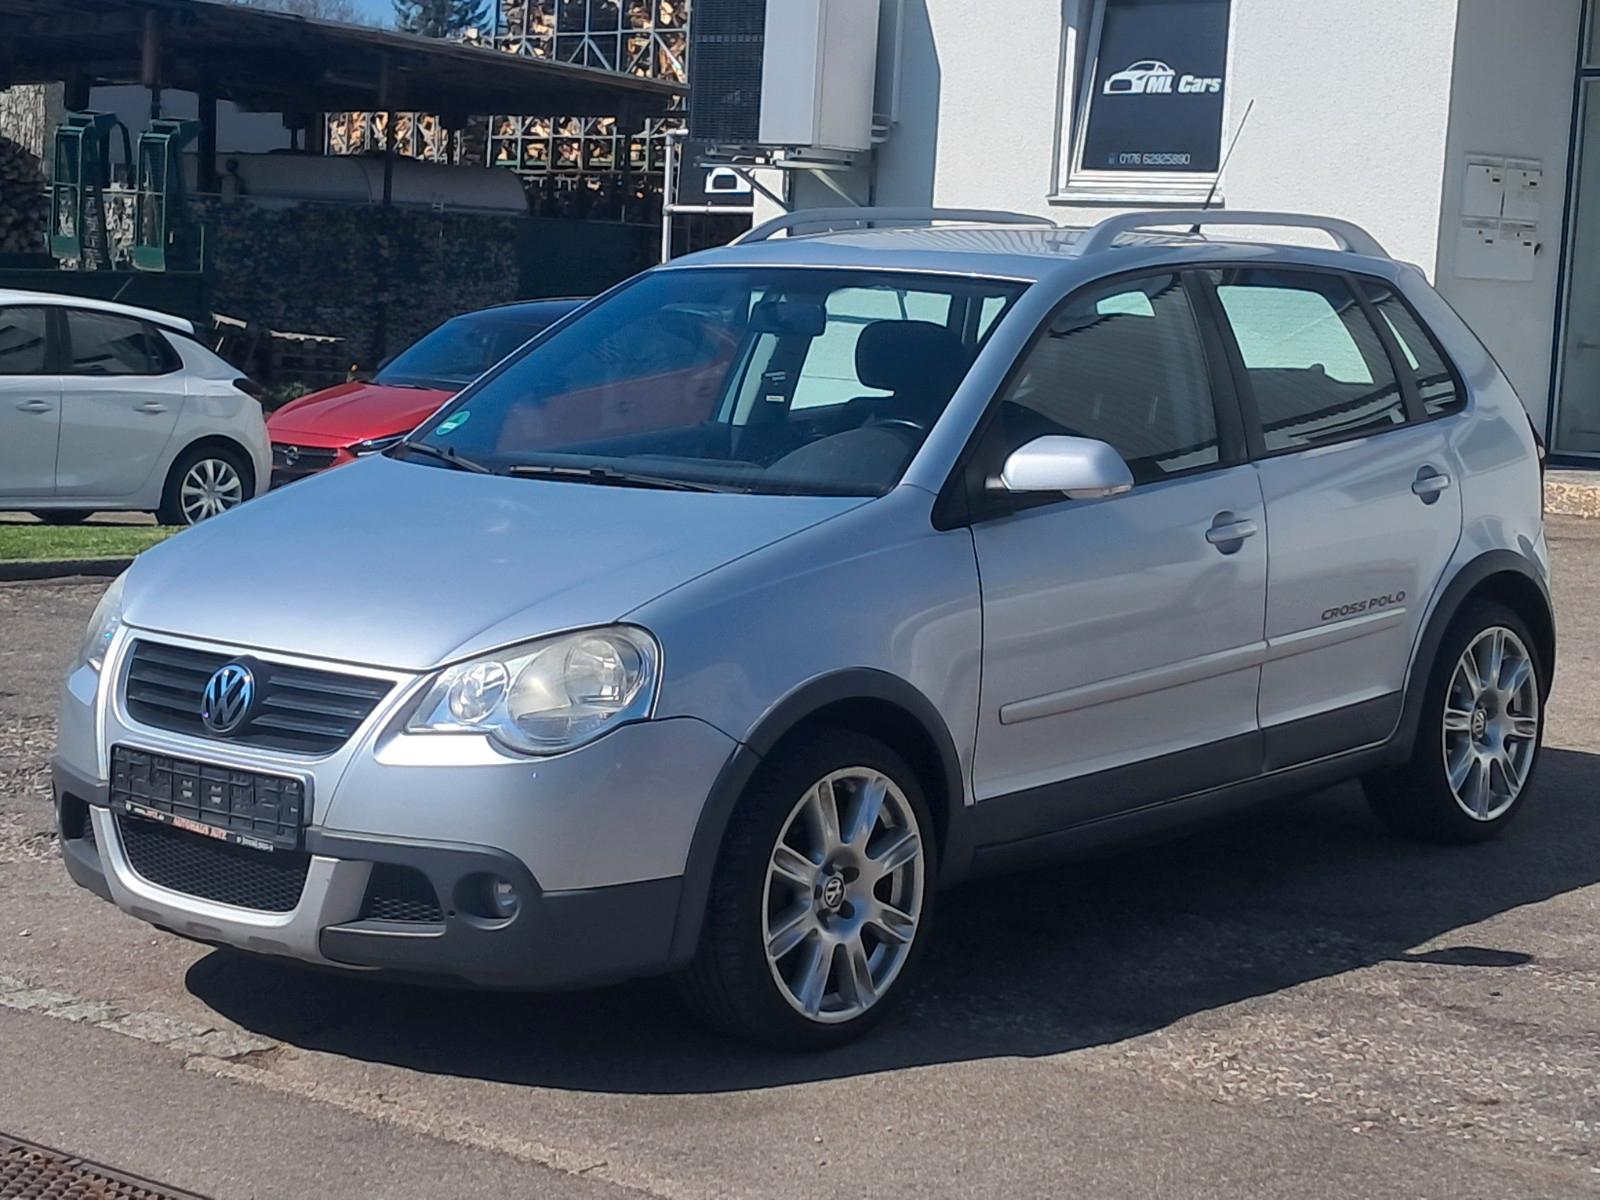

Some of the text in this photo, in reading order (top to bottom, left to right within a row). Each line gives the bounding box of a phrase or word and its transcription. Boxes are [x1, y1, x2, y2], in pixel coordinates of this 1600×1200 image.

[1145, 74, 1221, 93] ML Cars
[1120, 153, 1141, 165] 0176
[1321, 590, 1406, 620] CROSS POLO
[205, 665, 252, 728] VW
